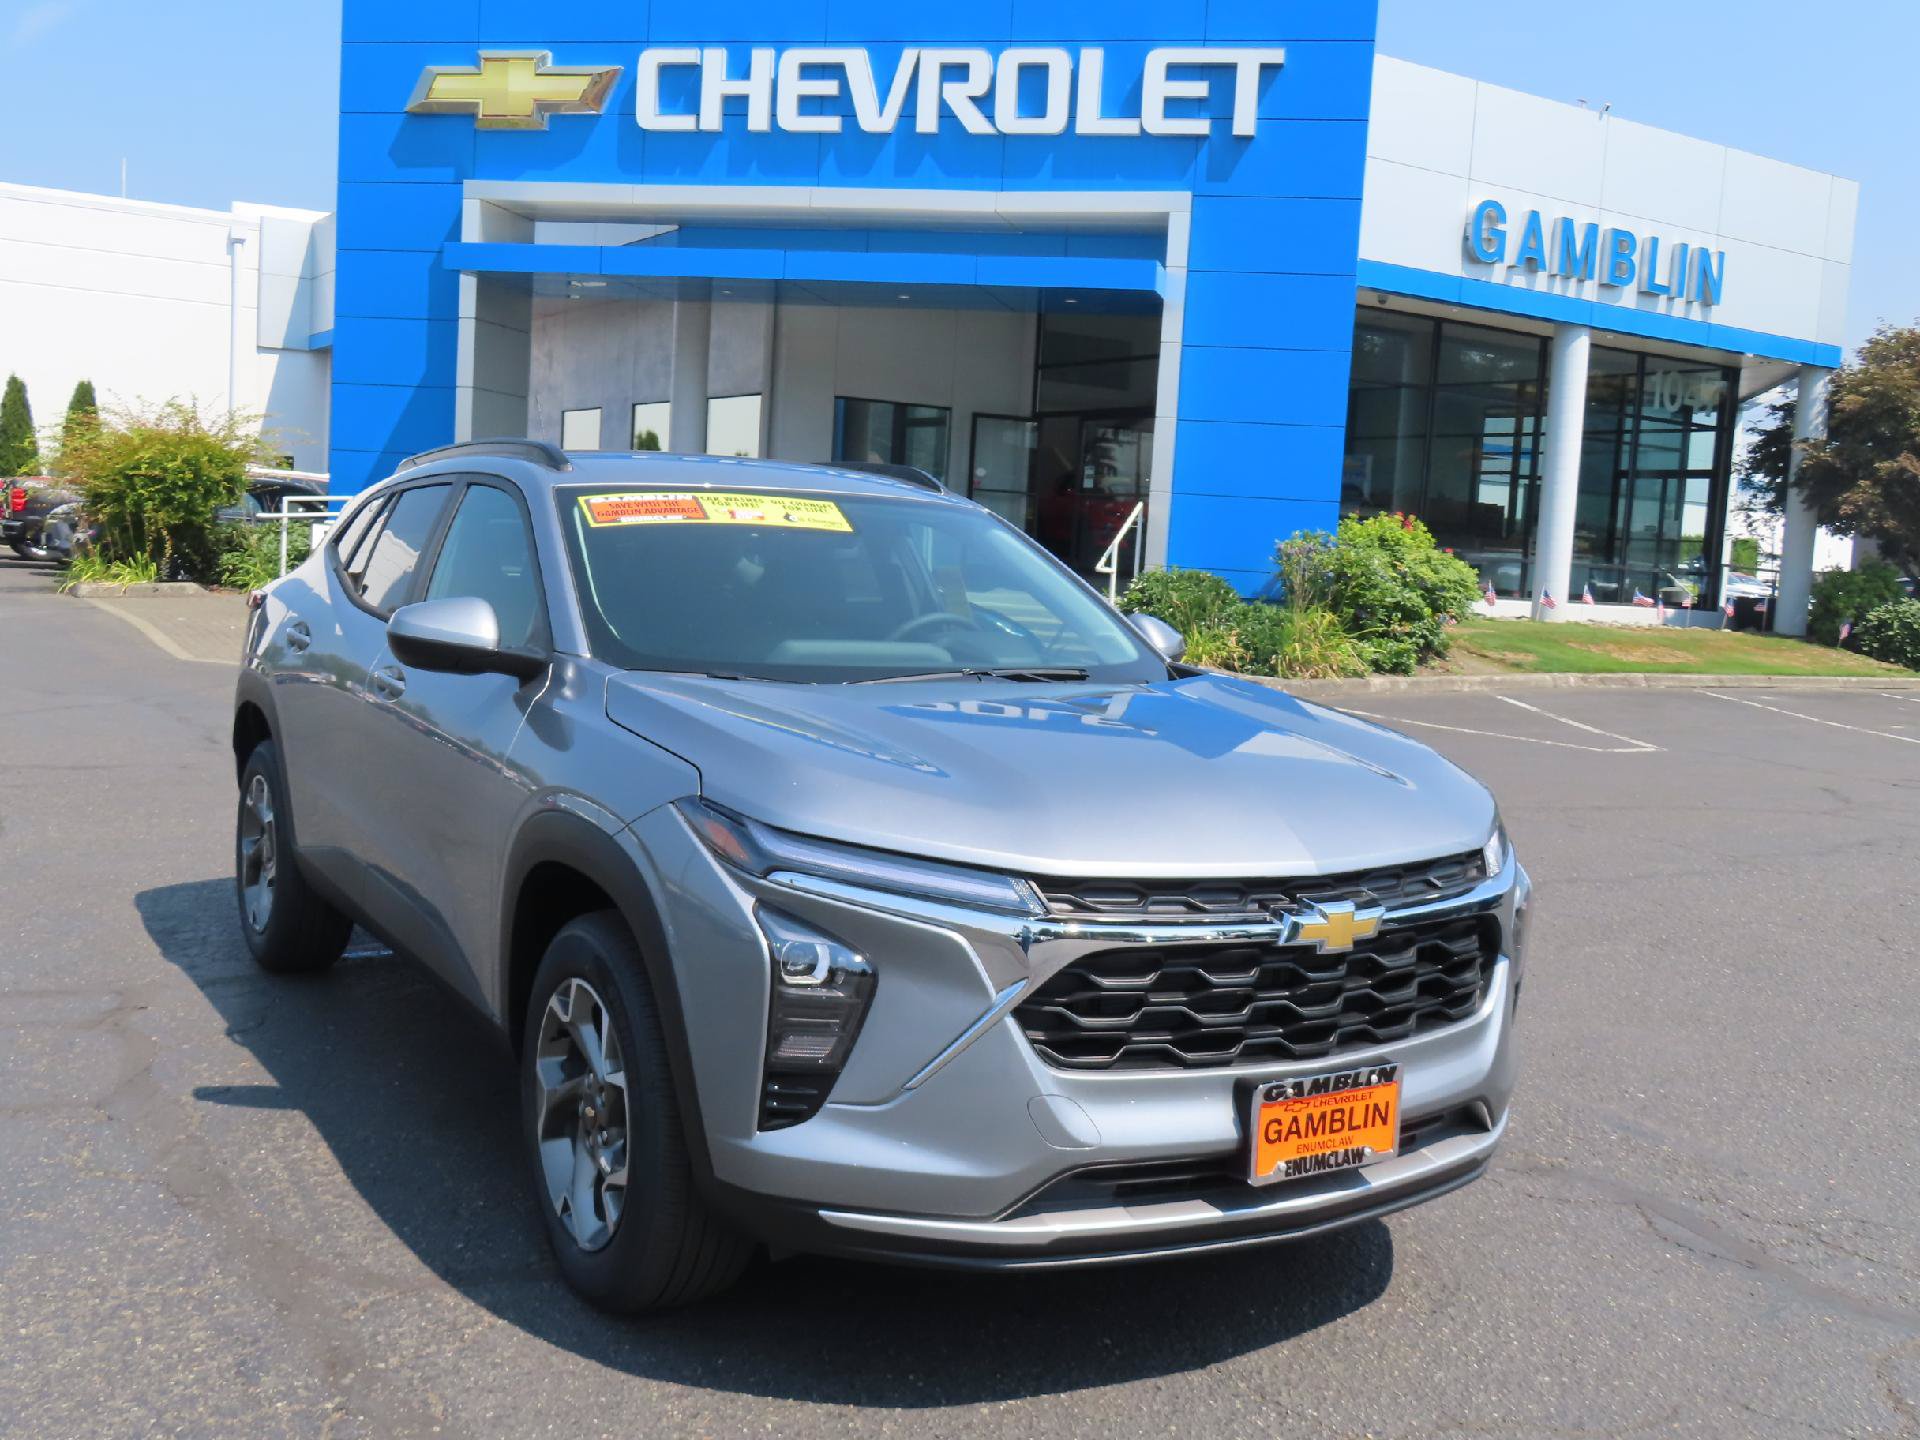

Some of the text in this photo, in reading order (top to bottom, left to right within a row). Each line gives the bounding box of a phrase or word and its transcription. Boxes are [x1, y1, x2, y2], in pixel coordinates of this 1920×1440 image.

[636, 47, 1285, 137] CHEVROLET
[1468, 199, 1725, 307] GAMBLIN
[597, 508, 641, 517] GAMBLIN
[1263, 1066, 1398, 1102] GAMBLIN
[1313, 1091, 1374, 1109] CHEVROLET
[1264, 1101, 1390, 1145] GAMBLIN
[1296, 1136, 1354, 1154] ENUMCLAW
[1285, 1147, 1366, 1178] ENUMCLAW
